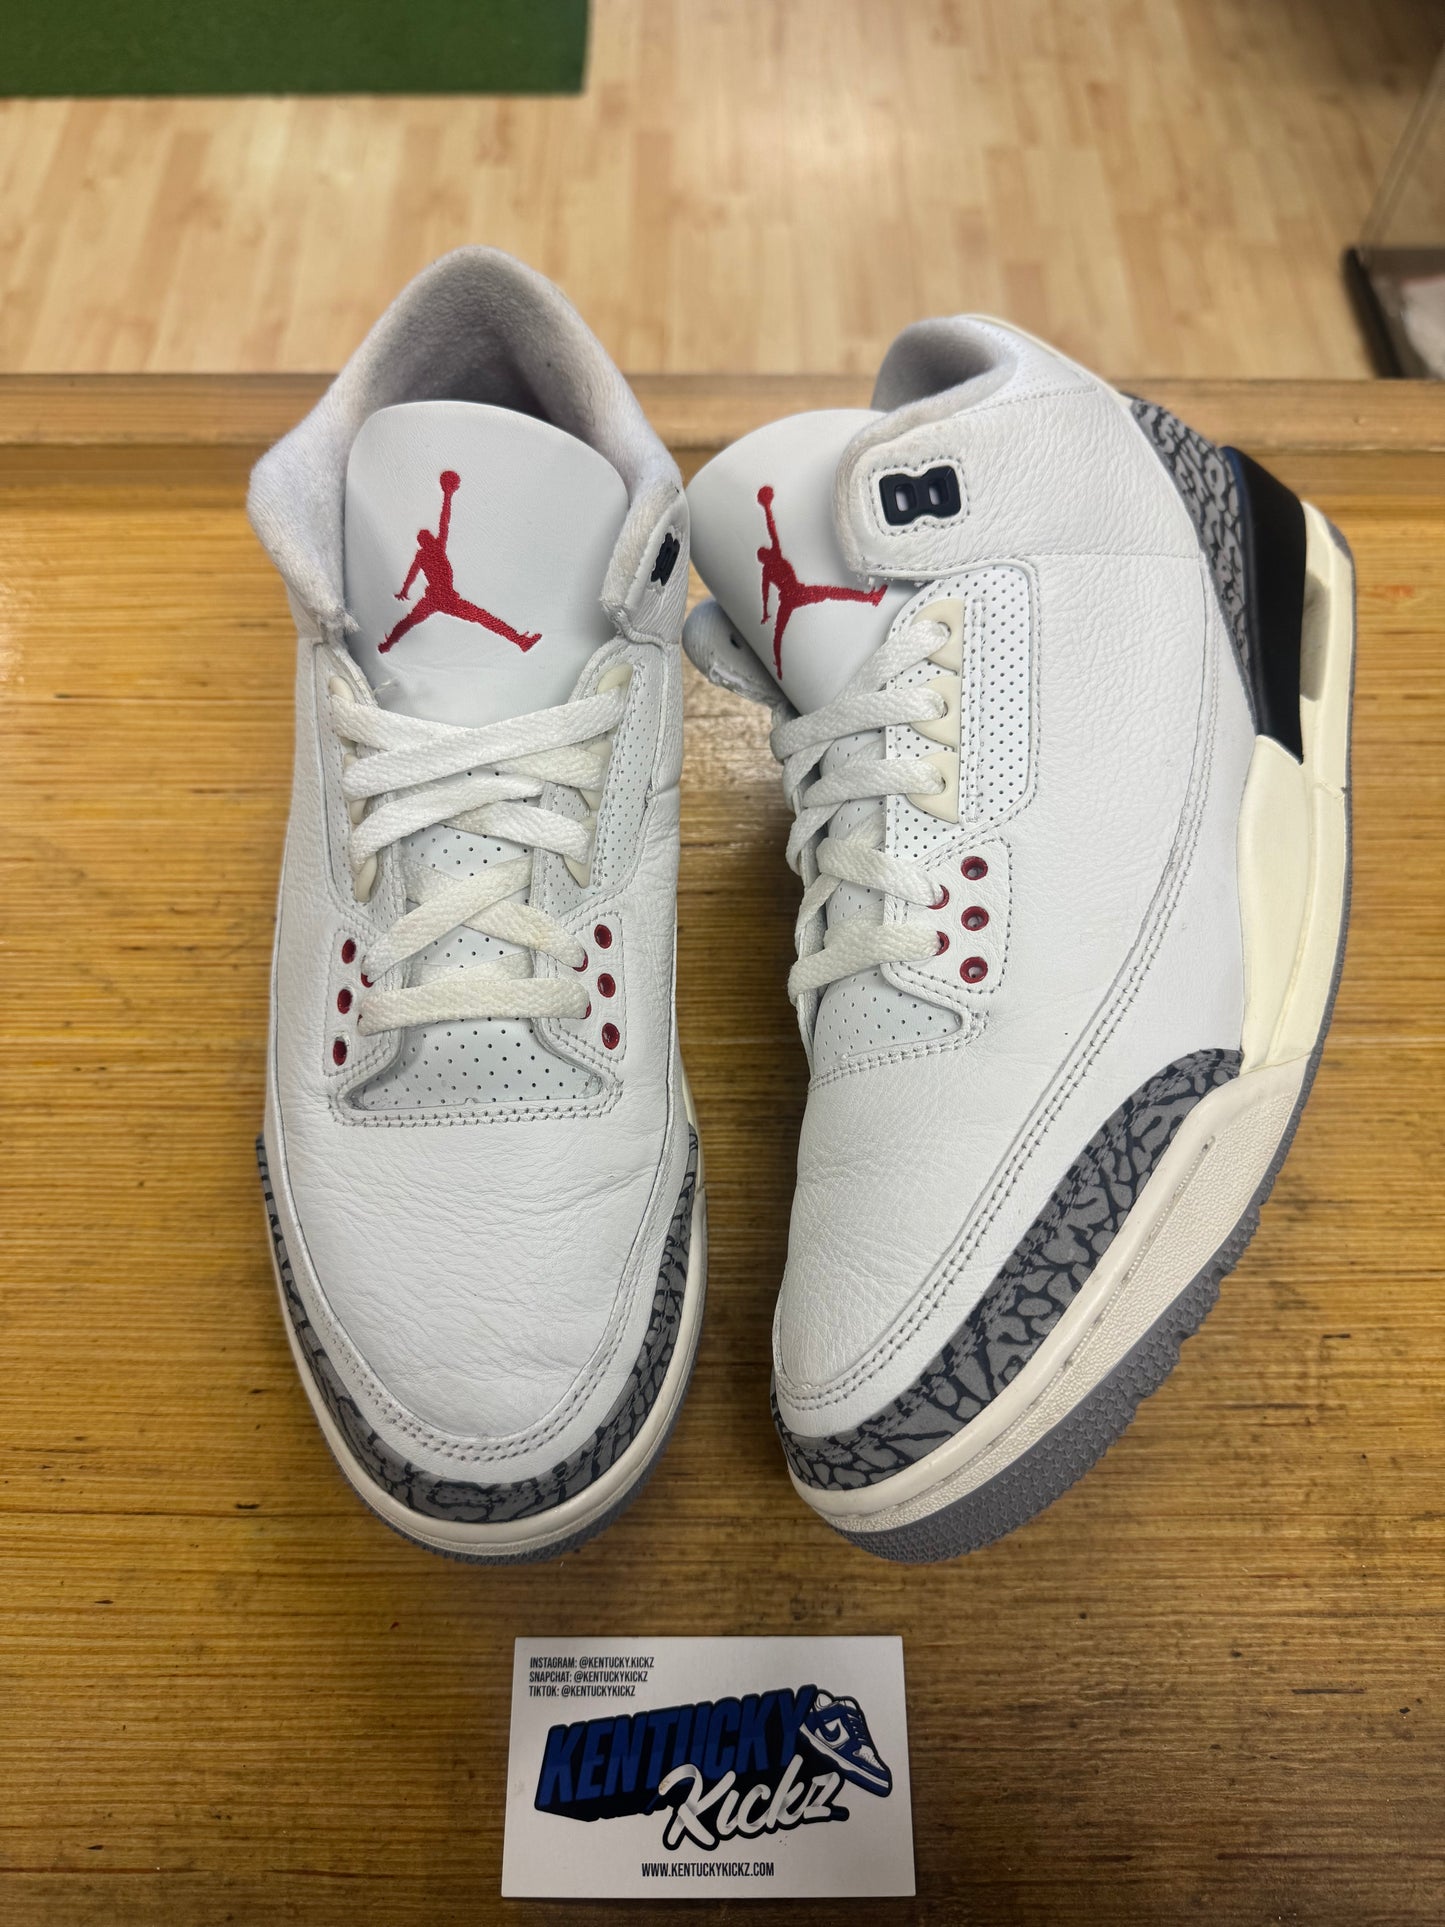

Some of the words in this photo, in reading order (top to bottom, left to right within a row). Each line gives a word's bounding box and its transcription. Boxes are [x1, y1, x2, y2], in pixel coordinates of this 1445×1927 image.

[530, 1656, 577, 1668] INSTAGRAM:
[579, 1656, 655, 1669] @KENTUCKY.KICKZ
[529, 1671, 572, 1683] SNAPCHAT:
[573, 1671, 648, 1683] @KENTUCKYKICKZ
[529, 1685, 560, 1697] TIKTOK:
[561, 1685, 636, 1697] @KENTUCKYKICKZ
[536, 1685, 817, 1812] KENTUCKY
[657, 1754, 842, 1848] Kickz
[641, 1863, 775, 1877] WWW.KENTUCKYKICKZ.COM
